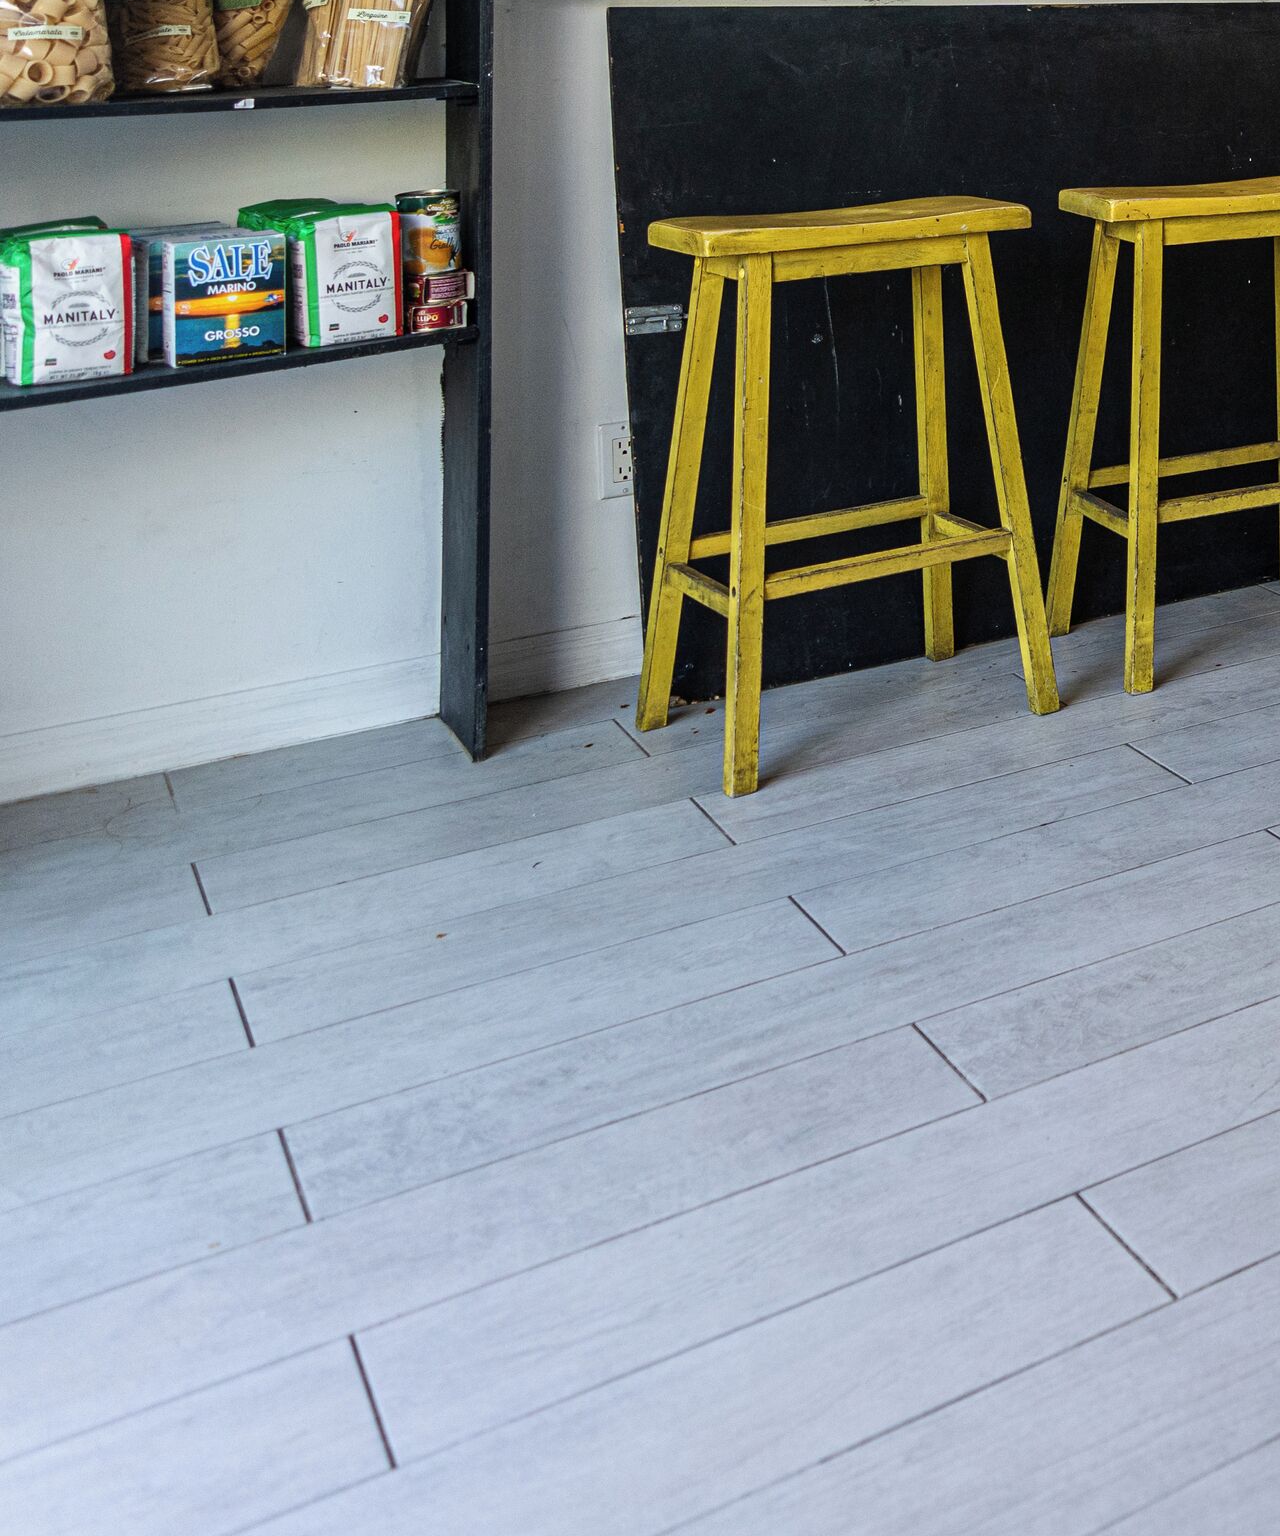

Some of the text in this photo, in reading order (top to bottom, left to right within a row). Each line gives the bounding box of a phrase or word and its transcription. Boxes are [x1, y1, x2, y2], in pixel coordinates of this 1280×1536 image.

[188, 240, 273, 287] SALE
[207, 281, 256, 295] MARINO
[326, 277, 387, 294] MANITALY
[44, 309, 115, 324] MANITALY
[204, 326, 260, 341] GROSSO
